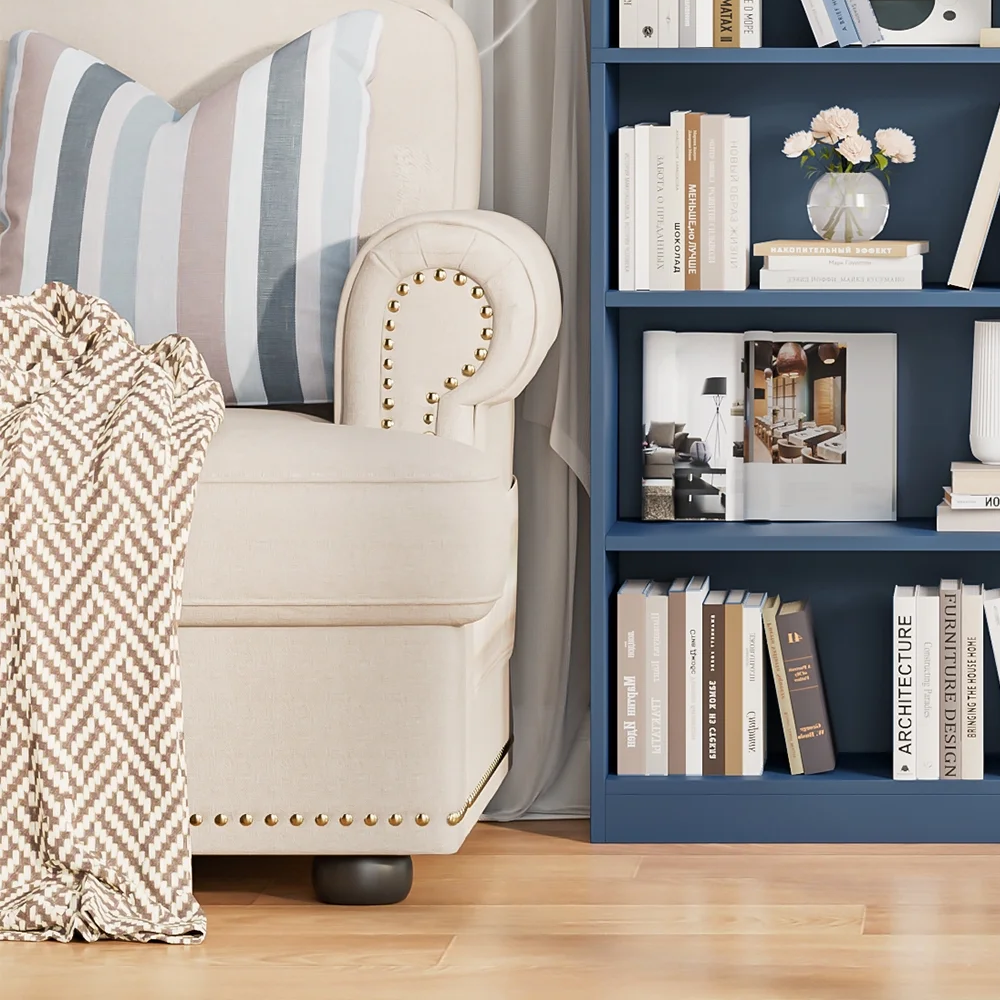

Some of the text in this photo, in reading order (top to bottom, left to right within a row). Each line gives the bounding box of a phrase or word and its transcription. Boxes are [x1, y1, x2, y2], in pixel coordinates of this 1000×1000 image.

[743, 13, 754, 35] МОРЕ
[835, 8, 846, 25] BRIEF
[656, 206, 665, 270] ПРЕДАННЫХ
[673, 222, 681, 274] ШОКОЛАД
[770, 245, 851, 254] НАКОПИТЕЛЬНЫЙ
[898, 615, 912, 756] ARCHITECTURE
[944, 593, 957, 777] FURNITURE DESIGN
[967, 636, 977, 738] BRINGING THE HOUSE HOME
